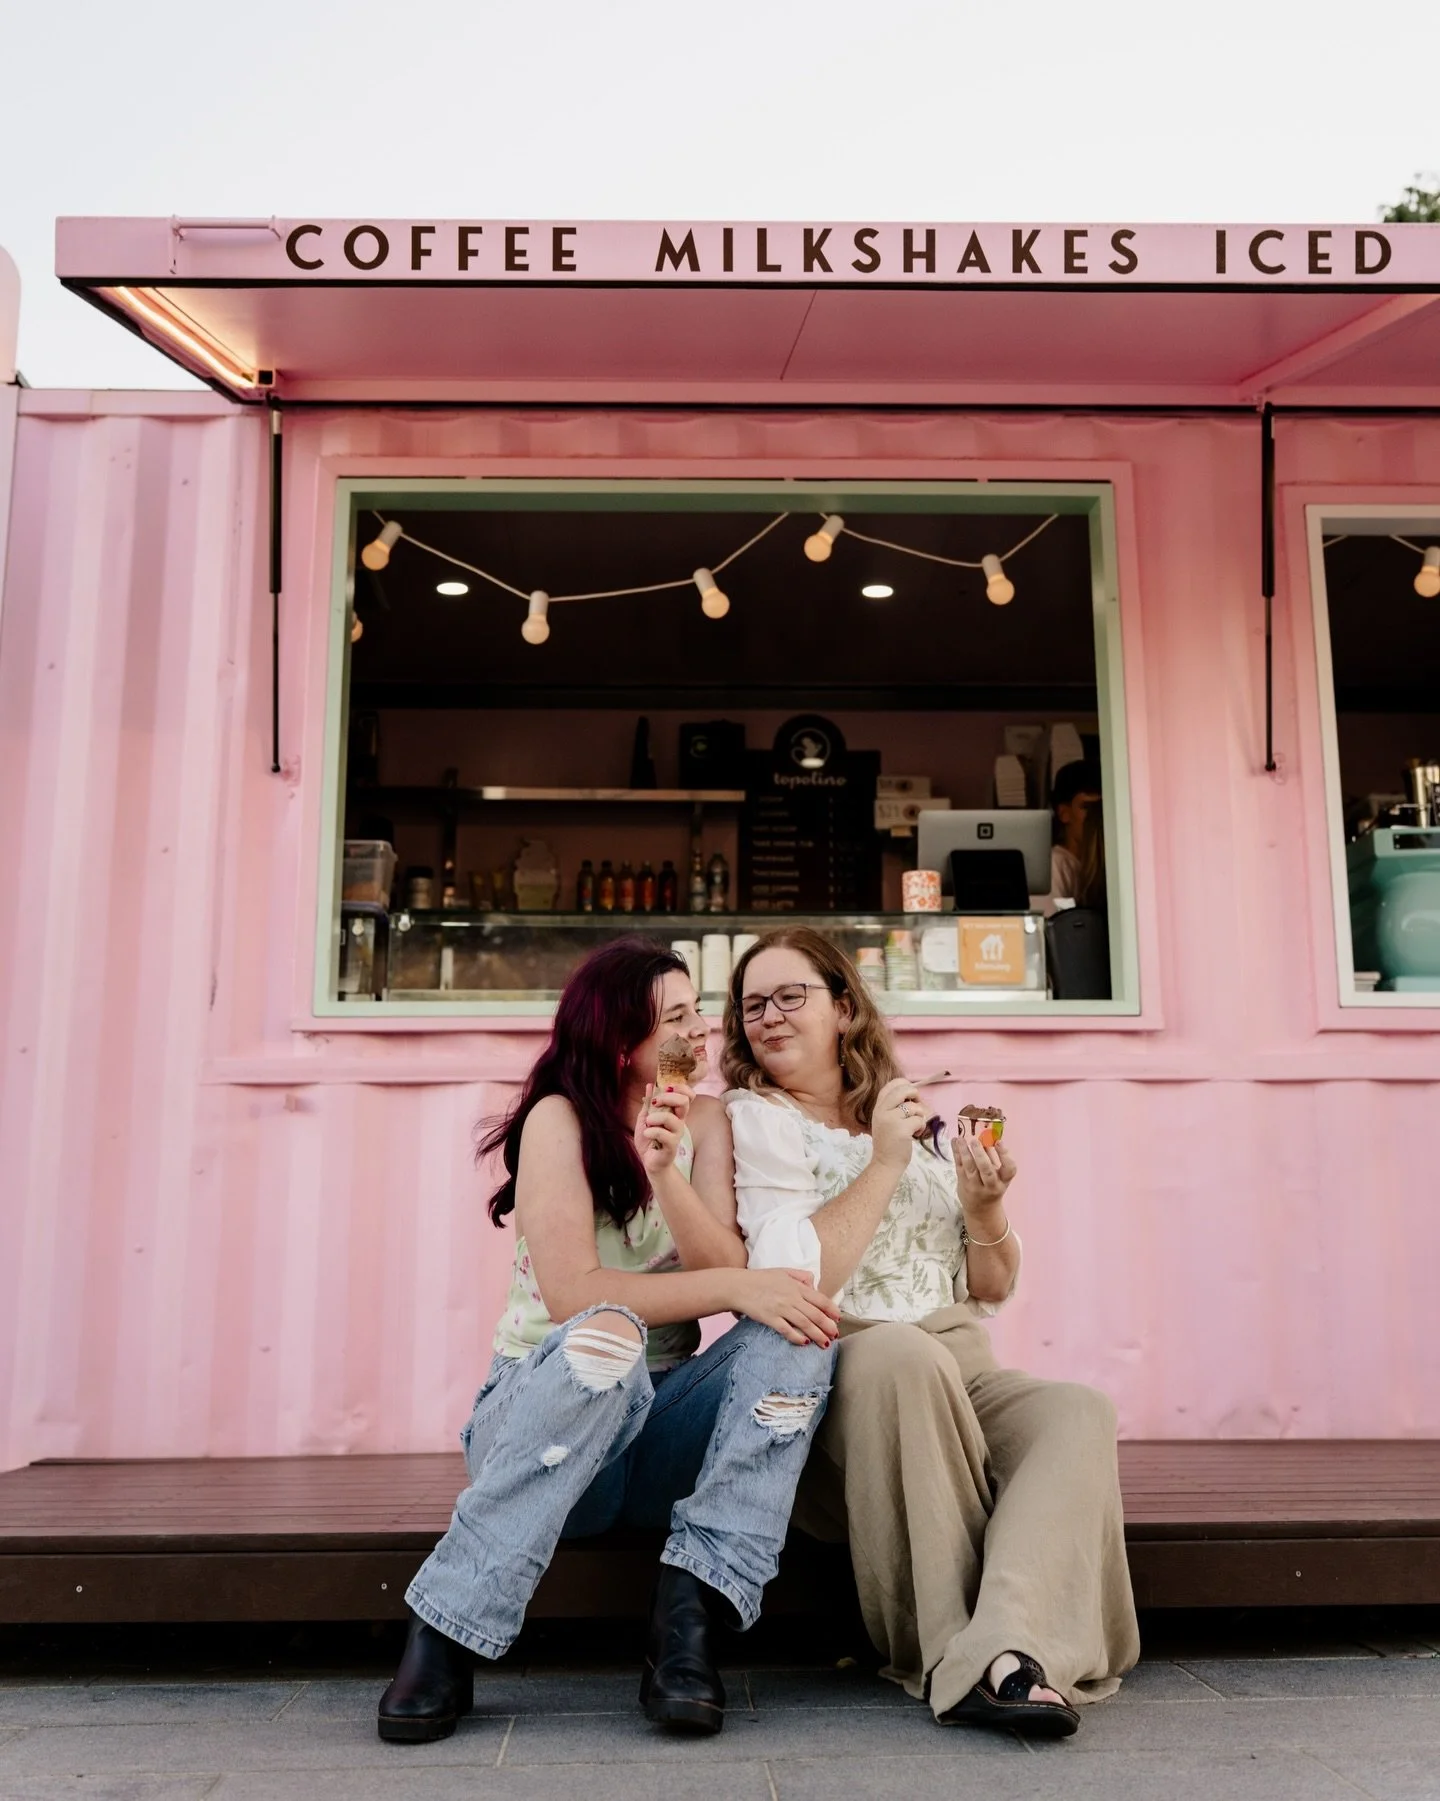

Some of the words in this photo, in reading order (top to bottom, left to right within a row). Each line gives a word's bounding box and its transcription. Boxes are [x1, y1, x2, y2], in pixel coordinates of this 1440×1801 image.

[285, 224, 577, 272] COFFEE
[654, 227, 1138, 275] MILKSHAKES
[1215, 229, 1392, 275] ICED
[773, 771, 848, 790] topolino
